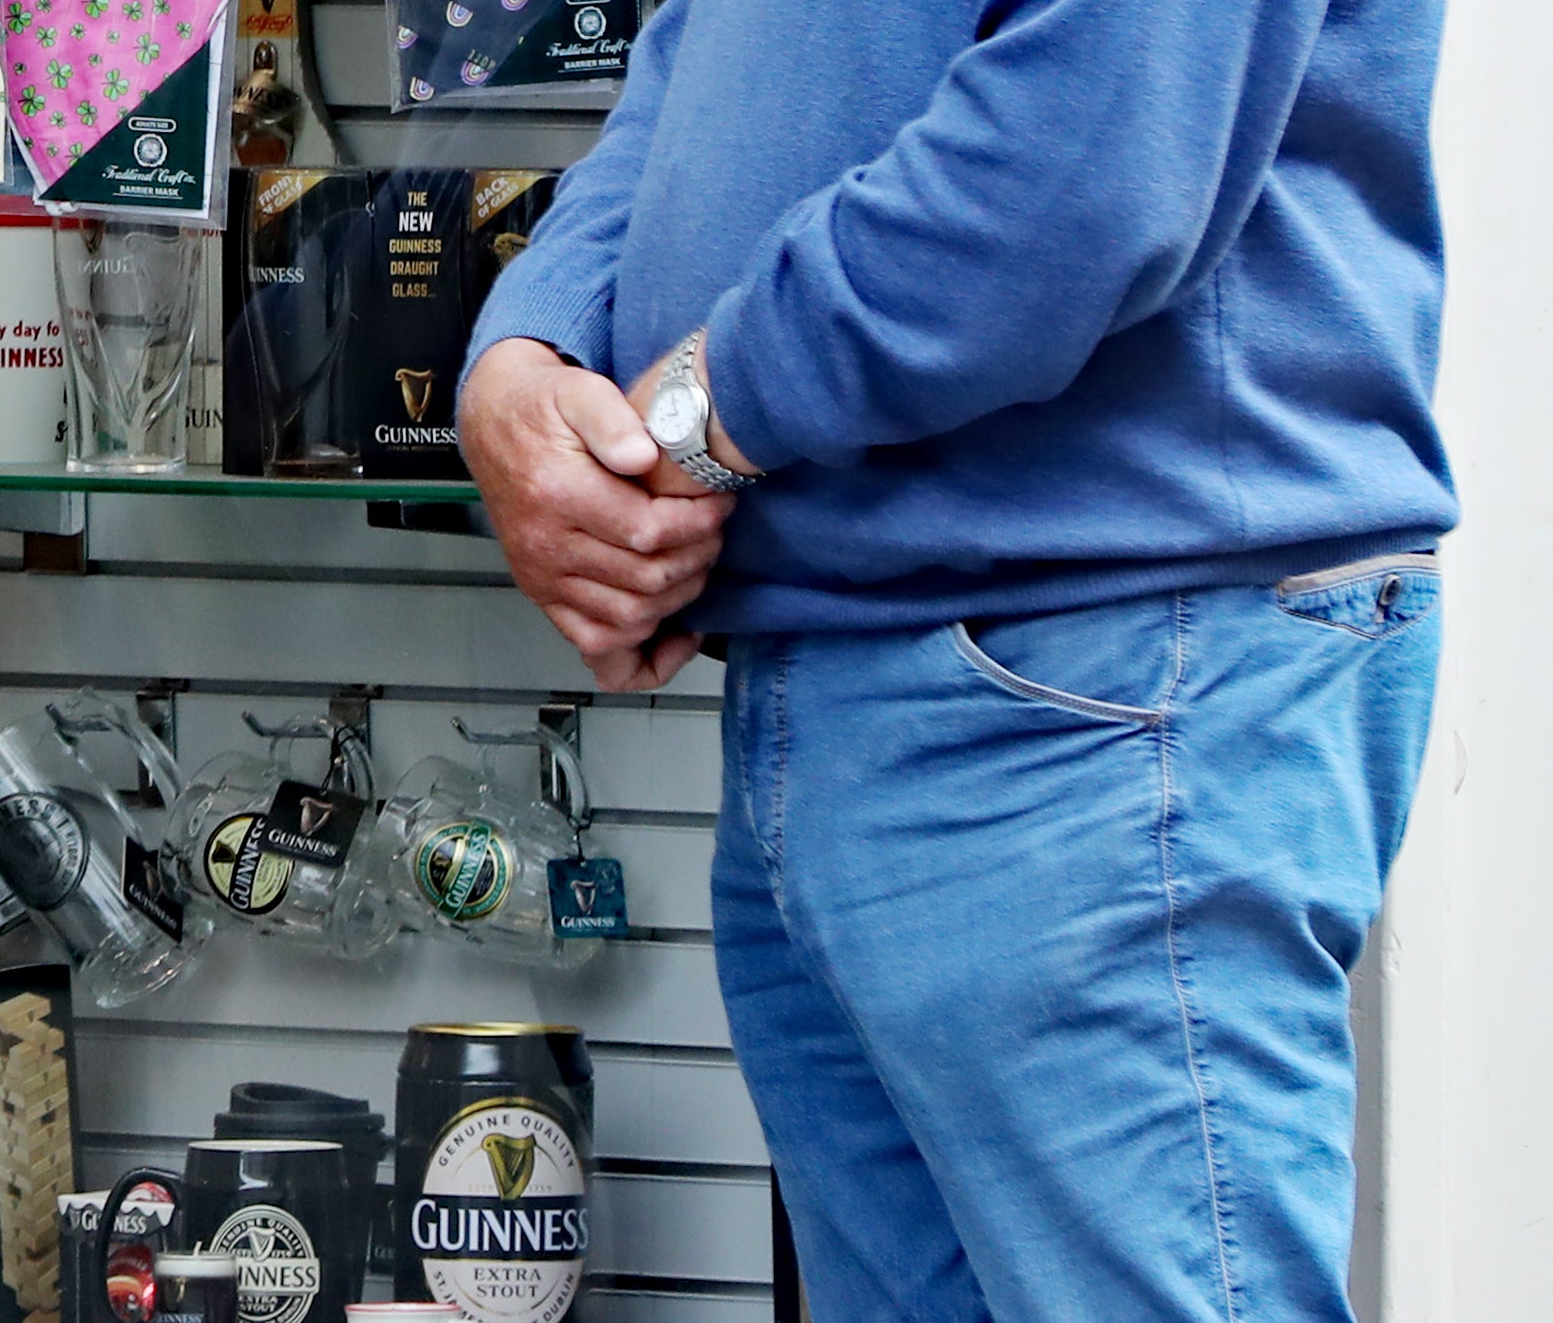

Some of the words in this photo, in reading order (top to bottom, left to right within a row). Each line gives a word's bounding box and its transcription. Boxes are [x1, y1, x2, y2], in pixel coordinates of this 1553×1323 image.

[546, 42, 596, 57] Traditional
[599, 40, 625, 56] Craft
[564, 60, 597, 70] BARRIER
[599, 58, 621, 67] MASK
[102, 165, 154, 182] Traditional
[157, 168, 183, 186] Craft
[119, 185, 153, 196] BARRIER
[155, 186, 179, 197] MASK
[257, 175, 293, 208] FRONT
[407, 191, 427, 207] THE
[473, 176, 509, 206] BACK
[477, 204, 491, 219] OF
[490, 181, 520, 209] GLASS
[398, 210, 434, 233] NEW
[388, 238, 442, 254] GUINNESS
[389, 260, 440, 276] DRAUGHT
[12, 319, 41, 342] day
[46, 319, 61, 338] fo
[374, 423, 458, 445] GUINNESS
[268, 828, 339, 858] GUINNESS
[445, 829, 490, 909] GUINNESS
[560, 916, 616, 929] GUINNESS
[438, 1113, 511, 1167] GENUINE
[520, 1116, 575, 1169] QUALITY
[411, 1198, 590, 1252] GUINNESS
[267, 1217, 306, 1257] QUALITY
[238, 1265, 318, 1288] INNESS
[474, 1268, 542, 1282] EXTRA
[476, 1284, 539, 1299] STOUT
[543, 1273, 575, 1323] DUBLIN
